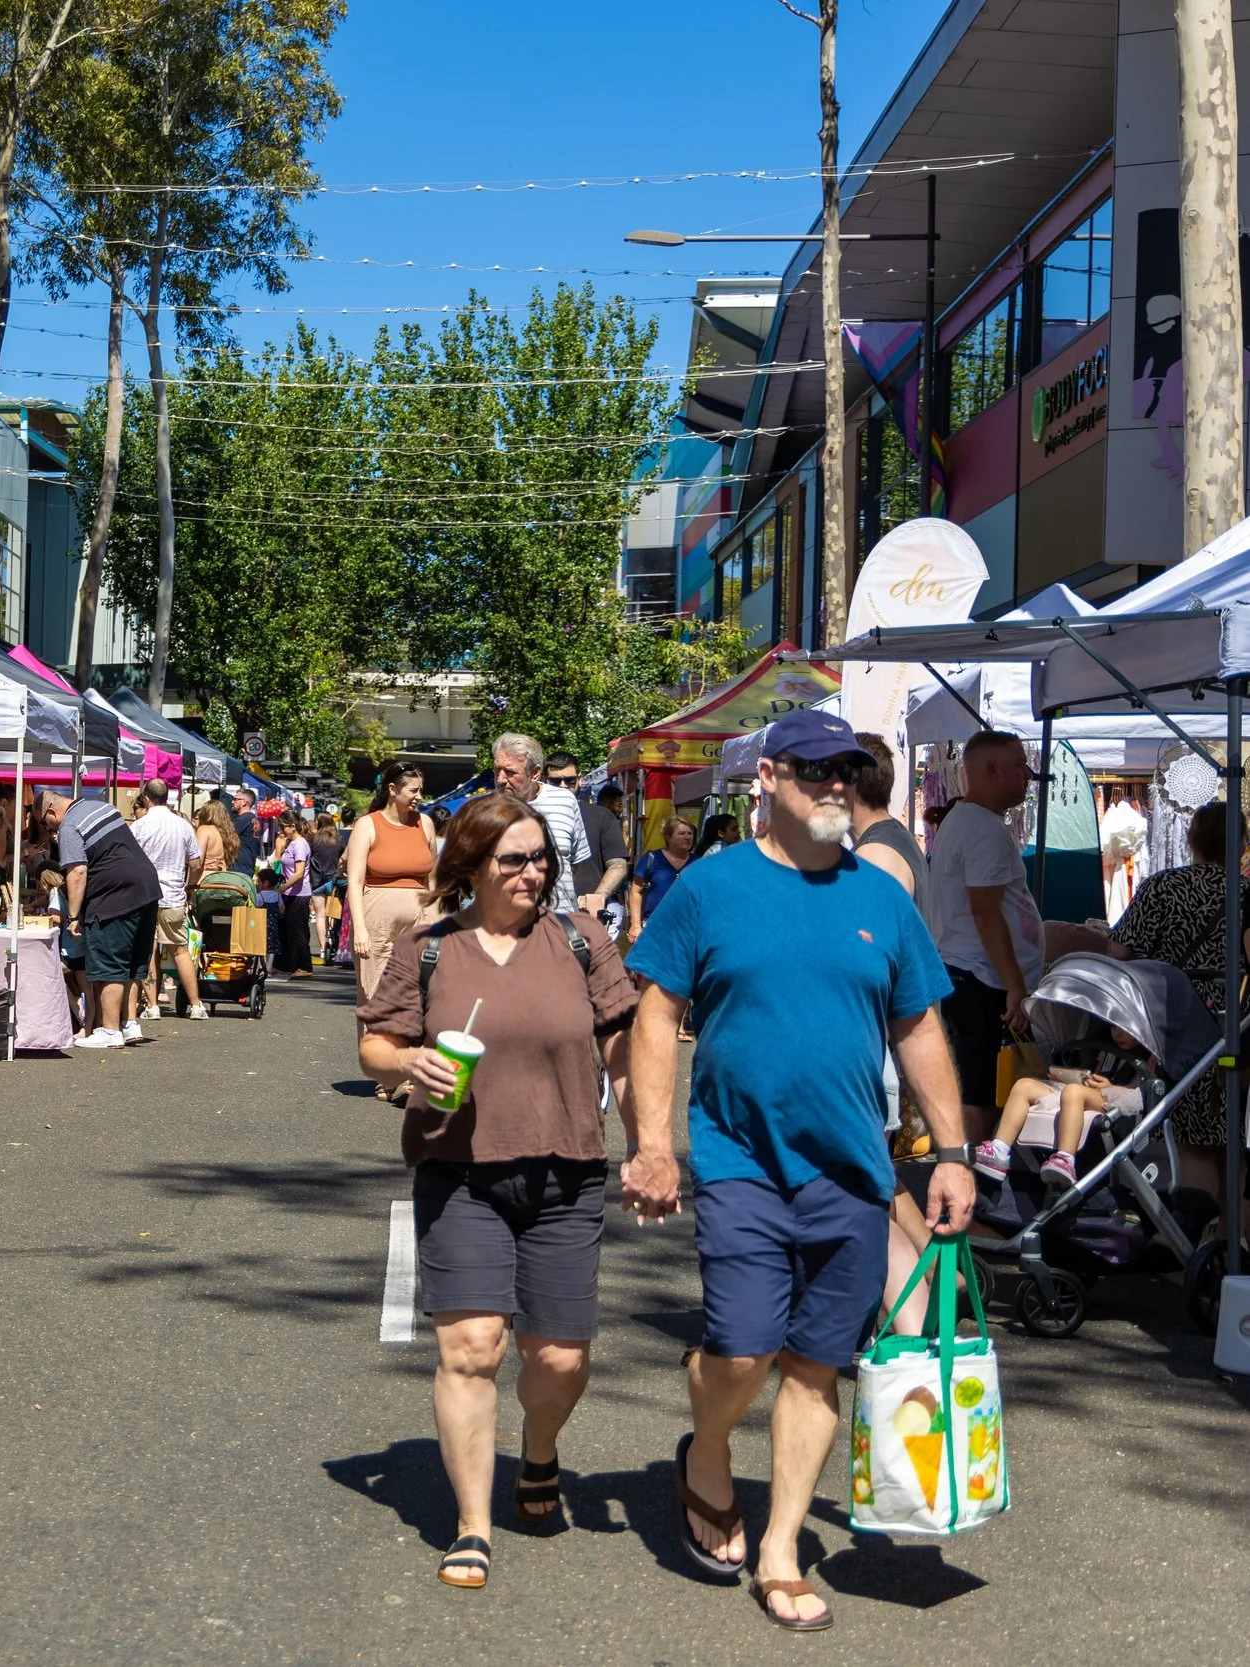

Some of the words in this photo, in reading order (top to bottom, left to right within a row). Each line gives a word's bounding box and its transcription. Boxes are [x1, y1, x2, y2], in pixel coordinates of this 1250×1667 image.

[890, 563, 952, 606] dm
[882, 687, 900, 726] DONNA
[249, 742, 262, 751] 20
